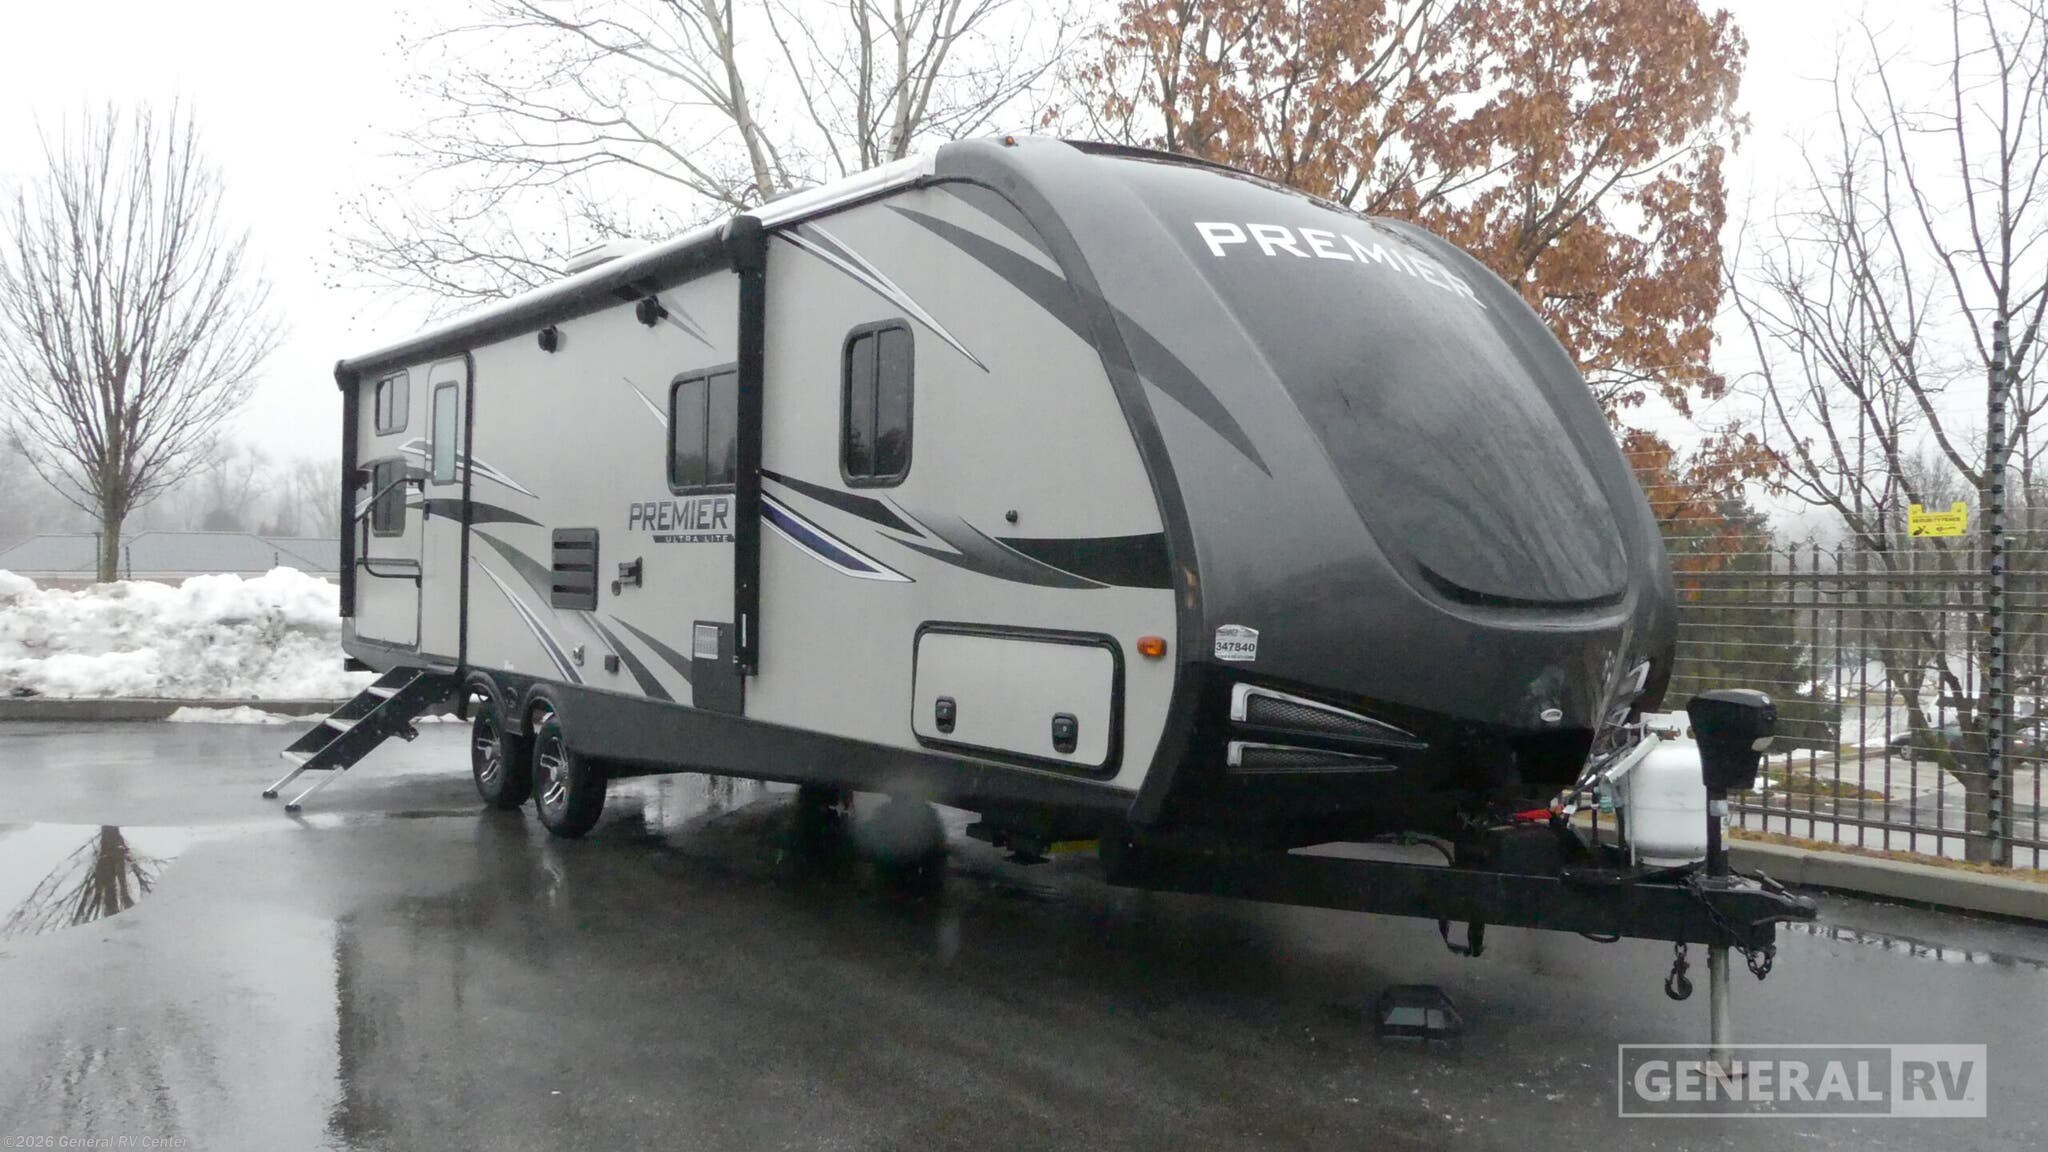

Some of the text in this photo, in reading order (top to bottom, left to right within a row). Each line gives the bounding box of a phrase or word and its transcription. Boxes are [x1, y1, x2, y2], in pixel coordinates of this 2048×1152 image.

[1194, 221, 1487, 309] PREMIER
[628, 498, 729, 531] PREMIER
[665, 534, 729, 543] ULTRA LITE
[1216, 642, 1256, 652] 347840
